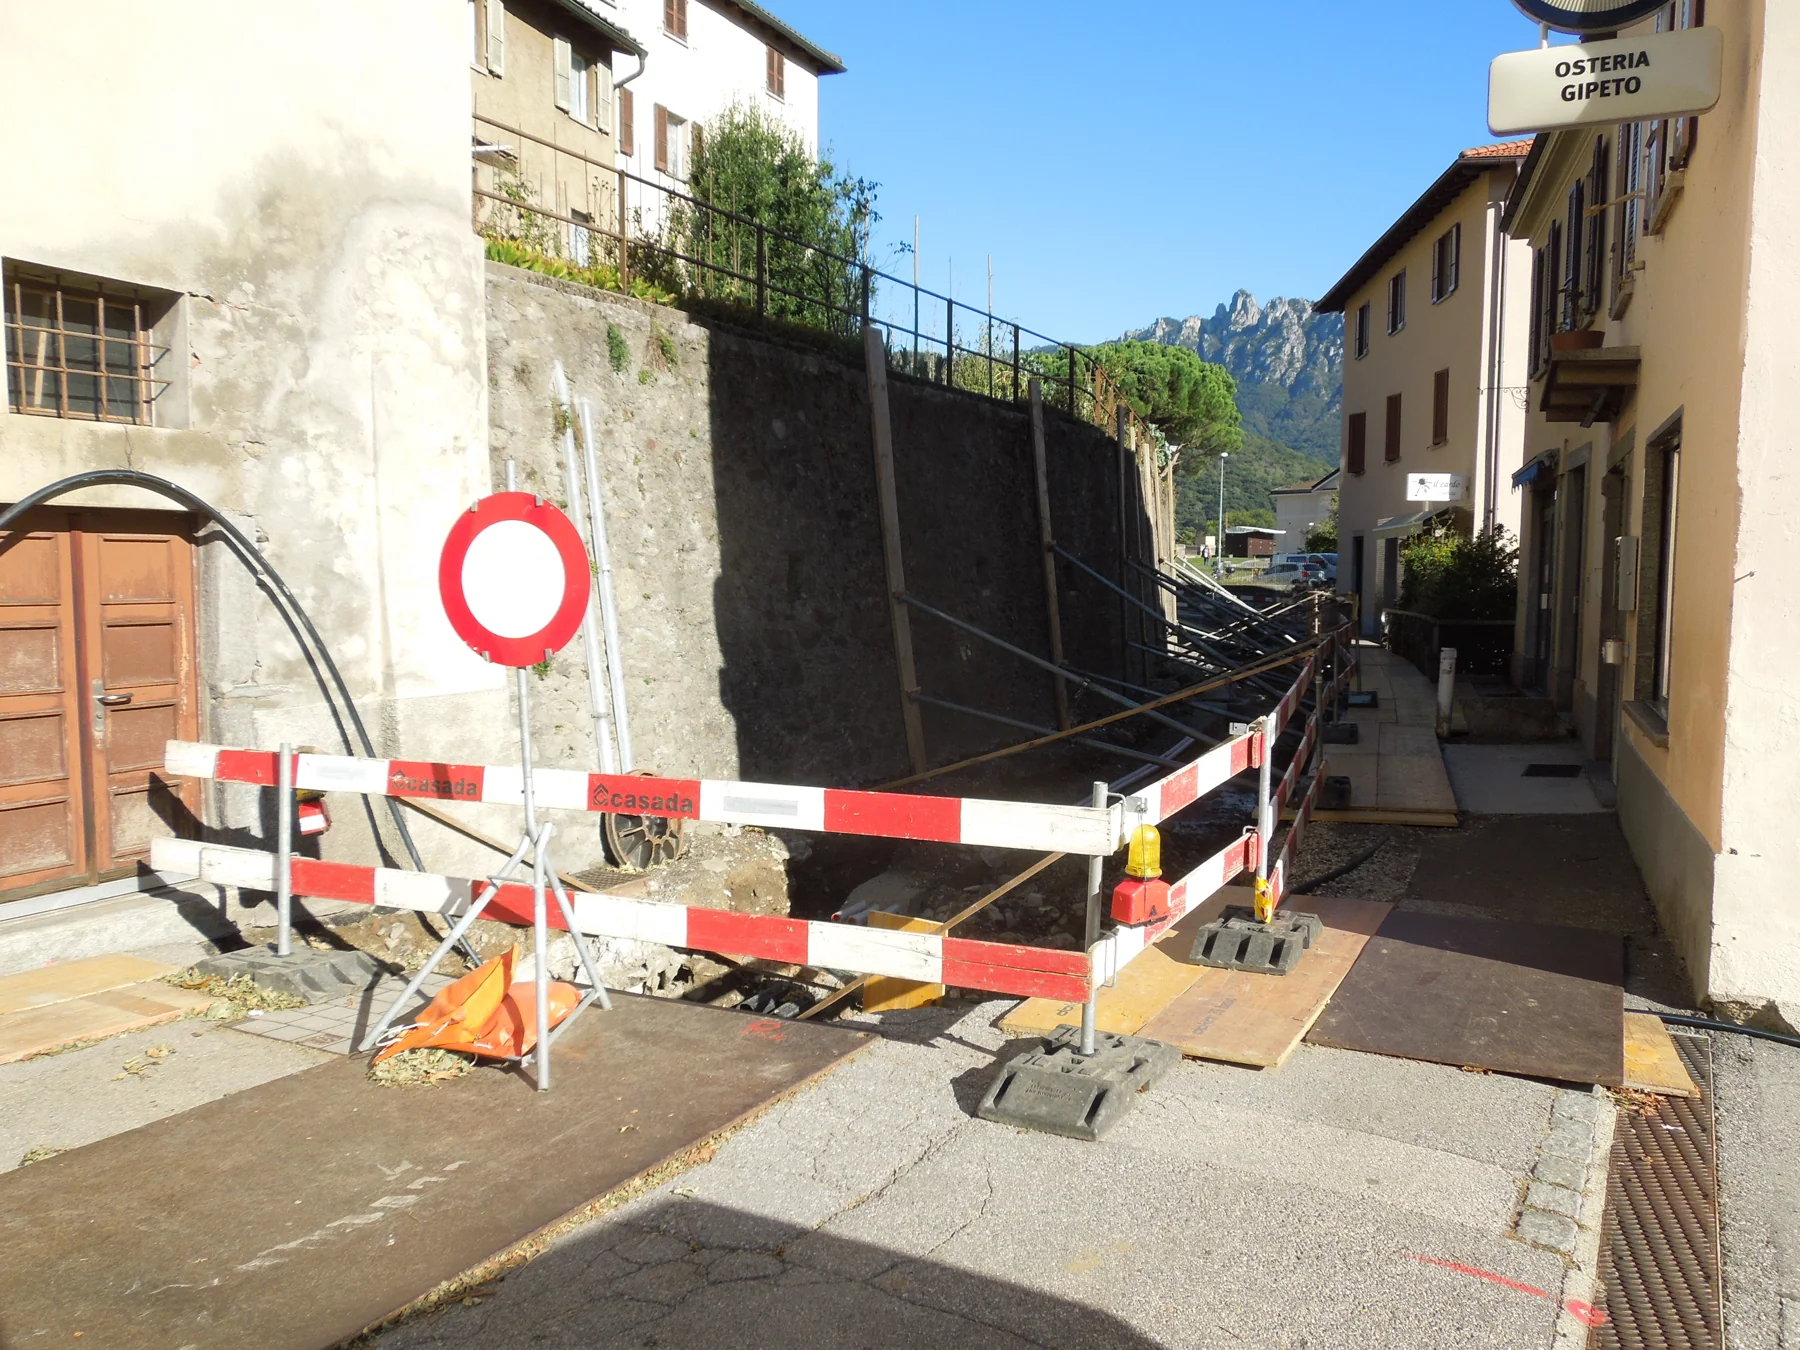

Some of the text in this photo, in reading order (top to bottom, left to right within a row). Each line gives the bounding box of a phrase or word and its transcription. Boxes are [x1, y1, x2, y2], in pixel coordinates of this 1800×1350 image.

[1555, 51, 1650, 78] OSTERIA
[1561, 76, 1641, 102] GIPETO
[408, 777, 478, 796] casada
[611, 792, 693, 813] casada
